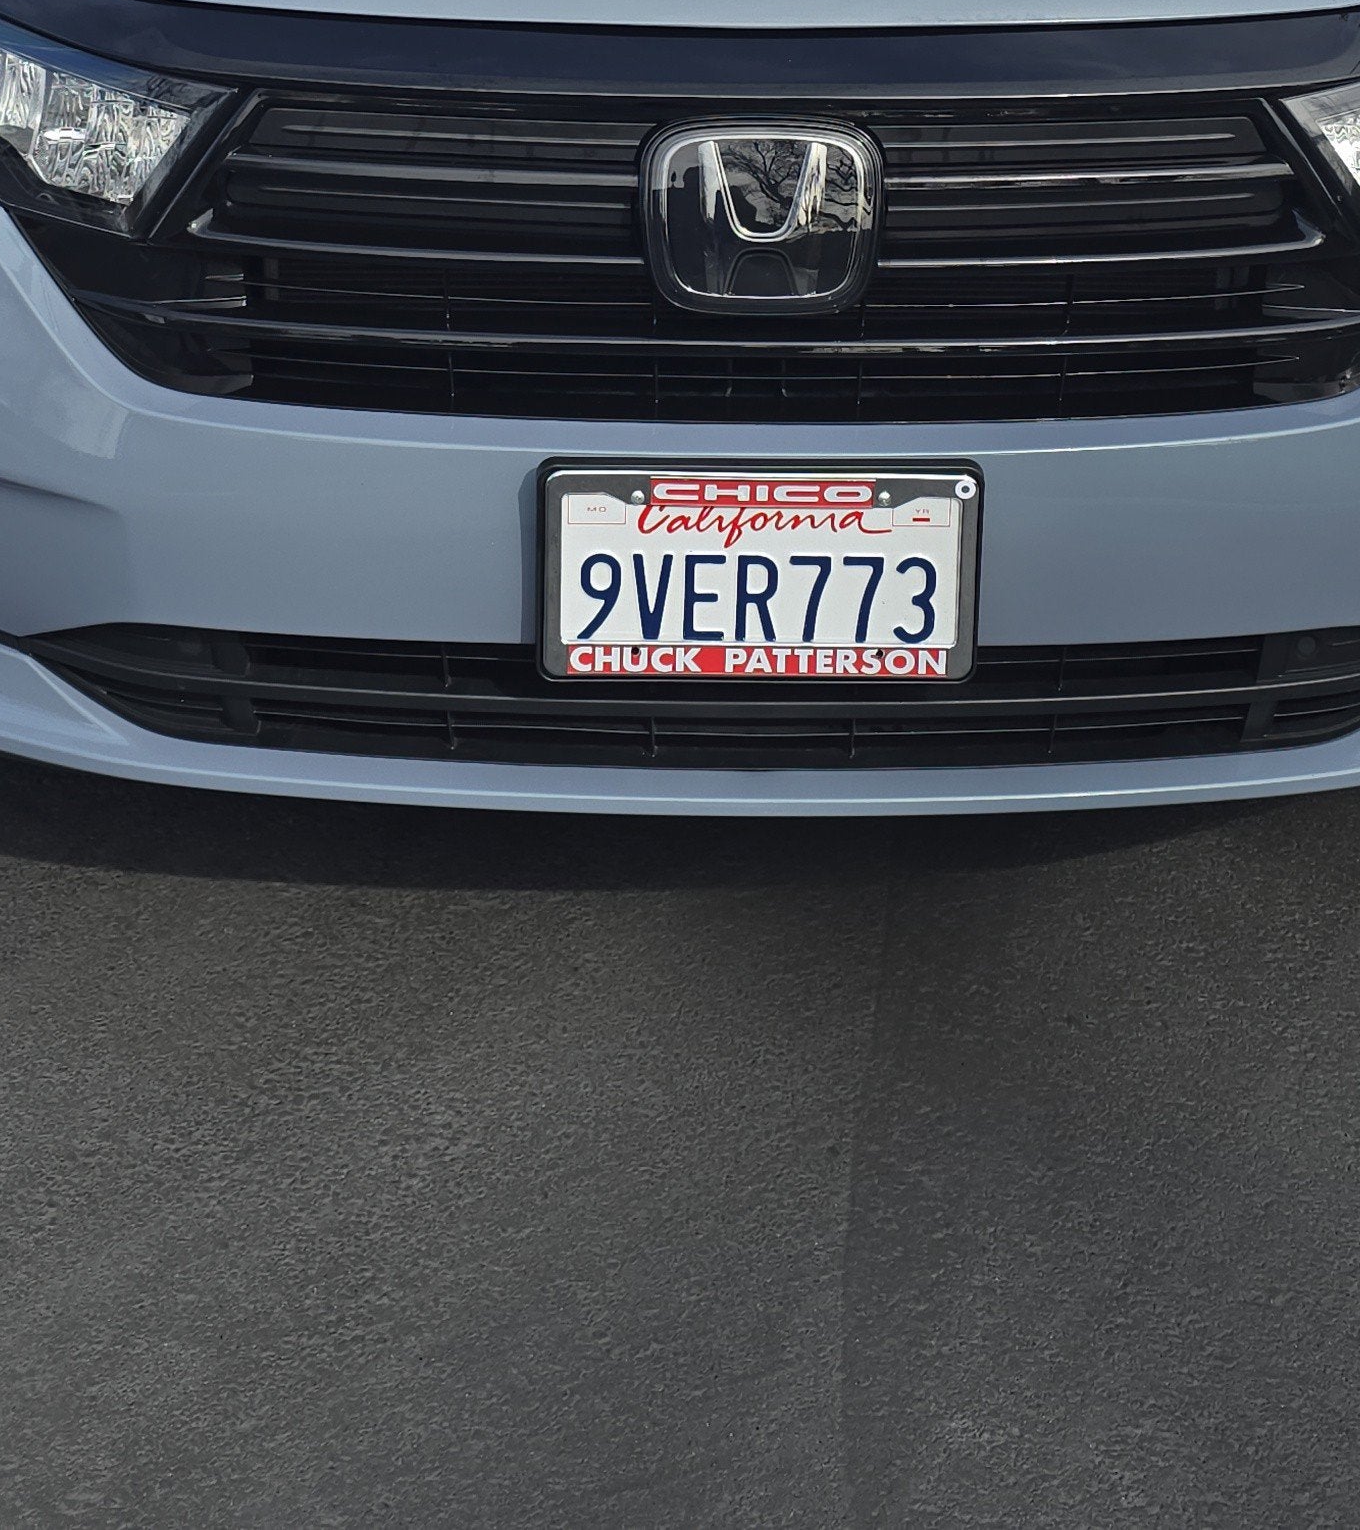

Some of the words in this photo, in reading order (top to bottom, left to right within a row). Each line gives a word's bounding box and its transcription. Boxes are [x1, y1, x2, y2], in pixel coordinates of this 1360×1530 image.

[652, 483, 873, 504] CHICO
[637, 503, 892, 548] California
[576, 553, 937, 644] 9VER773
[570, 645, 701, 675] CHUCK
[725, 646, 947, 676] PATTERSON
